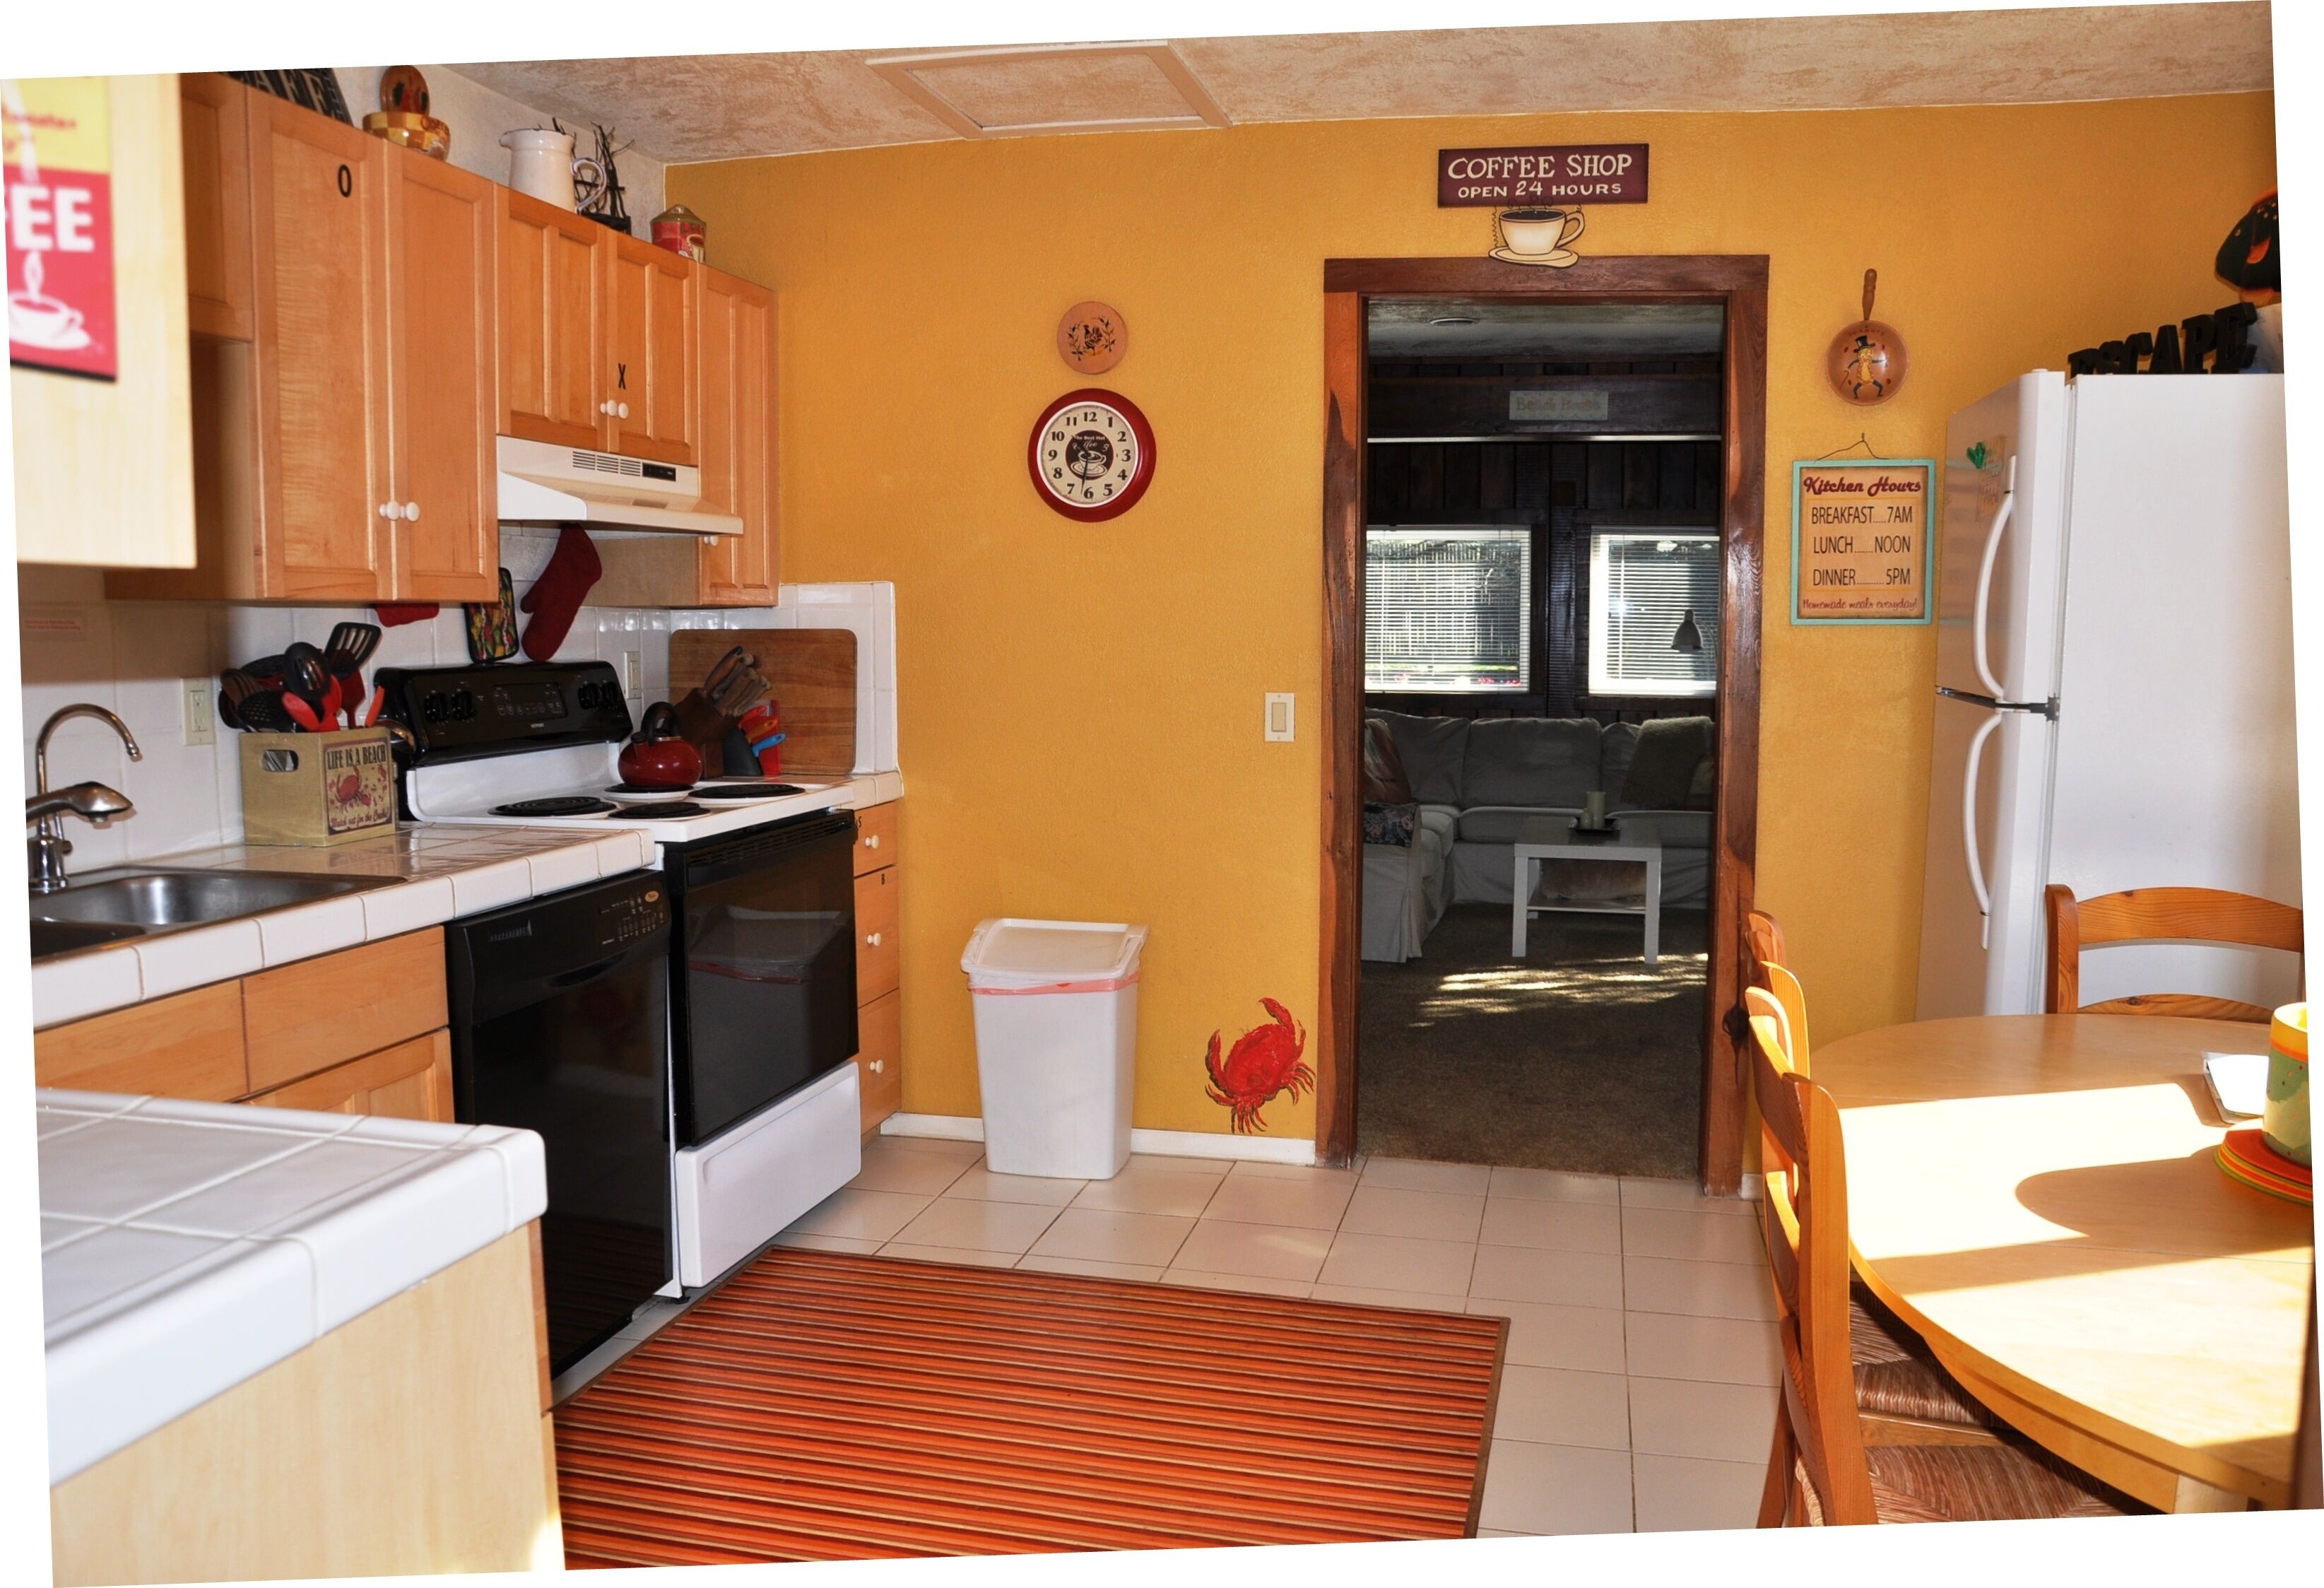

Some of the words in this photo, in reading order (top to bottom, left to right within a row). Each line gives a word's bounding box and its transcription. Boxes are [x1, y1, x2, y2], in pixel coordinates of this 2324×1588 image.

[1447, 155, 1555, 180] COFFEE
[1566, 153, 1633, 178] SHOP
[1458, 185, 1508, 199] OPEN
[1515, 180, 1543, 196] 24
[1552, 183, 1622, 196] HOURS
[4, 182, 95, 252] EE
[618, 363, 627, 389] X
[1066, 416, 1078, 426] 11
[1083, 411, 1097, 423] 12
[1107, 416, 1114, 428] 1
[1051, 430, 1065, 442] 10
[1117, 431, 1127, 442] 2
[1048, 449, 1058, 461] 9
[1121, 449, 1131, 461] 3
[1053, 467, 1063, 479] 8
[1117, 469, 1128, 481] 4
[1066, 483, 1075, 495] 7
[1102, 483, 1113, 496] 5
[1803, 476, 1864, 495] Kitchen
[1867, 476, 1921, 497] Hours
[1083, 487, 1094, 499] 6
[1887, 505, 1913, 523] 7AM
[1874, 535, 1911, 553] NOON
[1885, 567, 1911, 585] 5PM
[1803, 598, 1847, 609] Homemade
[1848, 597, 1874, 609] meals
[327, 750, 344, 770] LIFE
[346, 748, 353, 767] IS
[355, 748, 361, 765] A
[362, 744, 387, 765] BEACH
[881, 874, 885, 885] B
